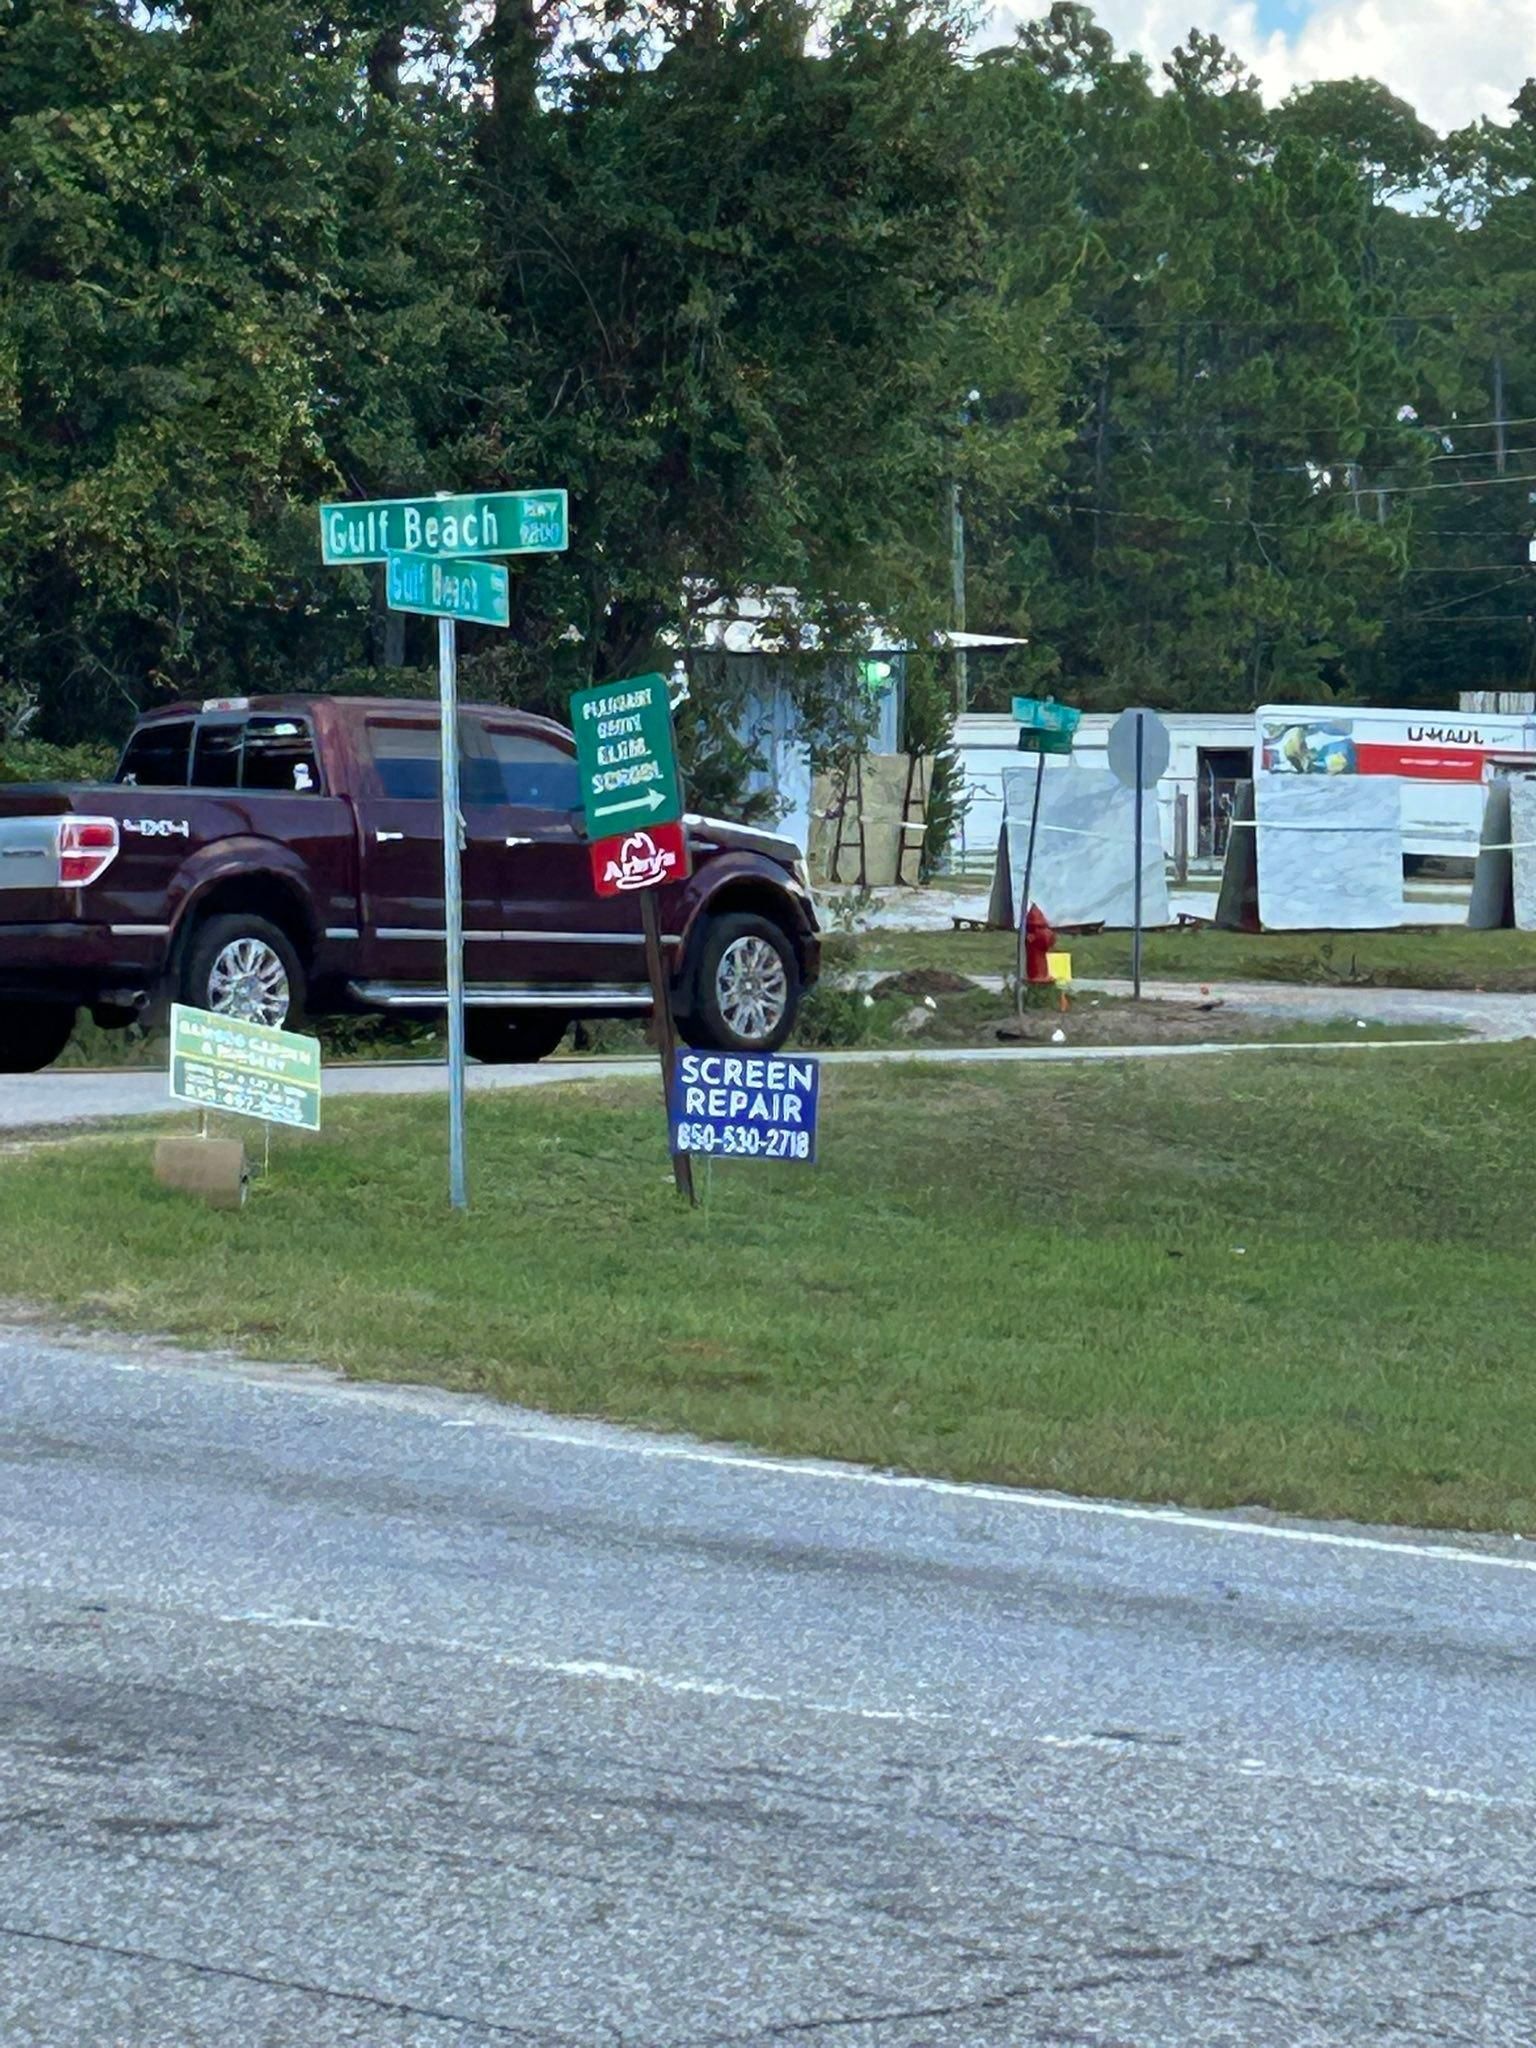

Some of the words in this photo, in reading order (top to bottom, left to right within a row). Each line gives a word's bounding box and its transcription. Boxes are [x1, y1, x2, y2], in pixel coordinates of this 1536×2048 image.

[330, 510, 389, 554] Gulf
[405, 504, 498, 550] Beach
[681, 1055, 813, 1092] SCREEN
[686, 1087, 802, 1122] REPAIR
